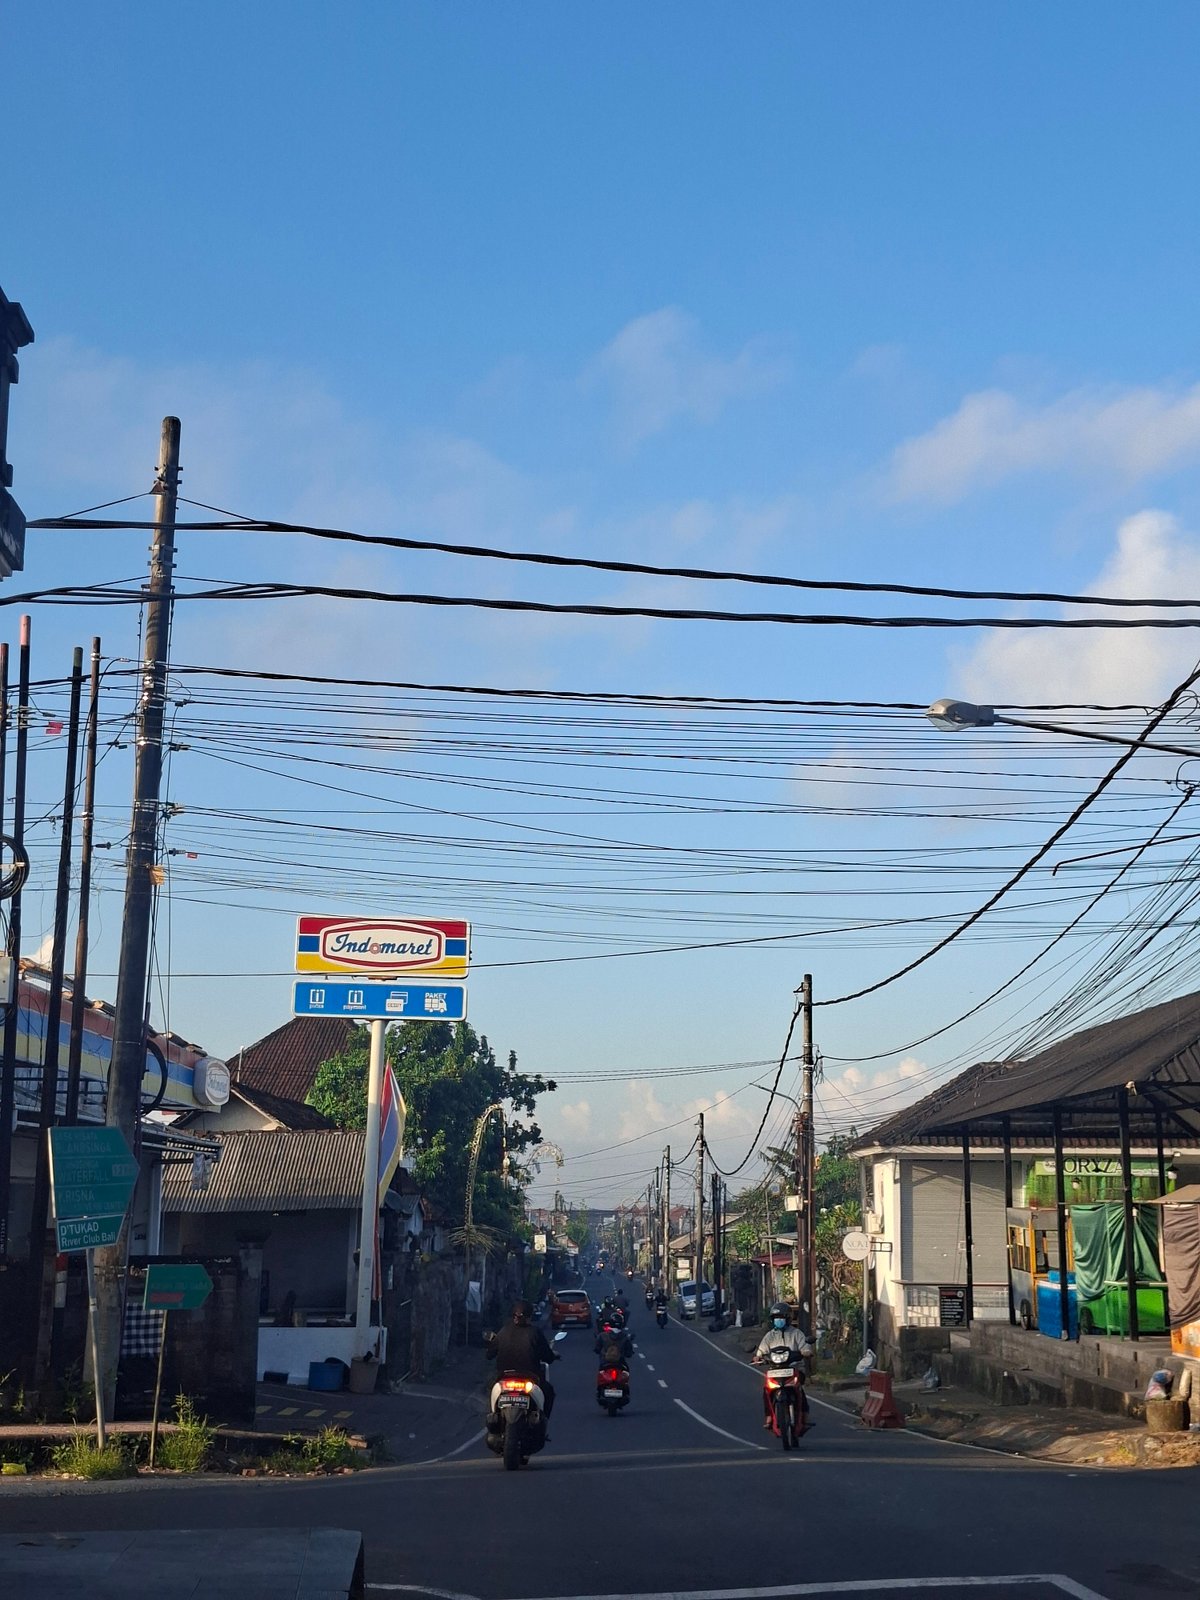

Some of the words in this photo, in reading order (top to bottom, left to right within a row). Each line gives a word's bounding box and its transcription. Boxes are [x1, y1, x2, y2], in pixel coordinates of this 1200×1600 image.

[331, 934, 433, 955] Indomaret
[60, 1221, 99, 1236] D'TUKAD
[61, 1235, 82, 1248] River
[83, 1233, 100, 1244] Club
[101, 1232, 116, 1241] Bali
